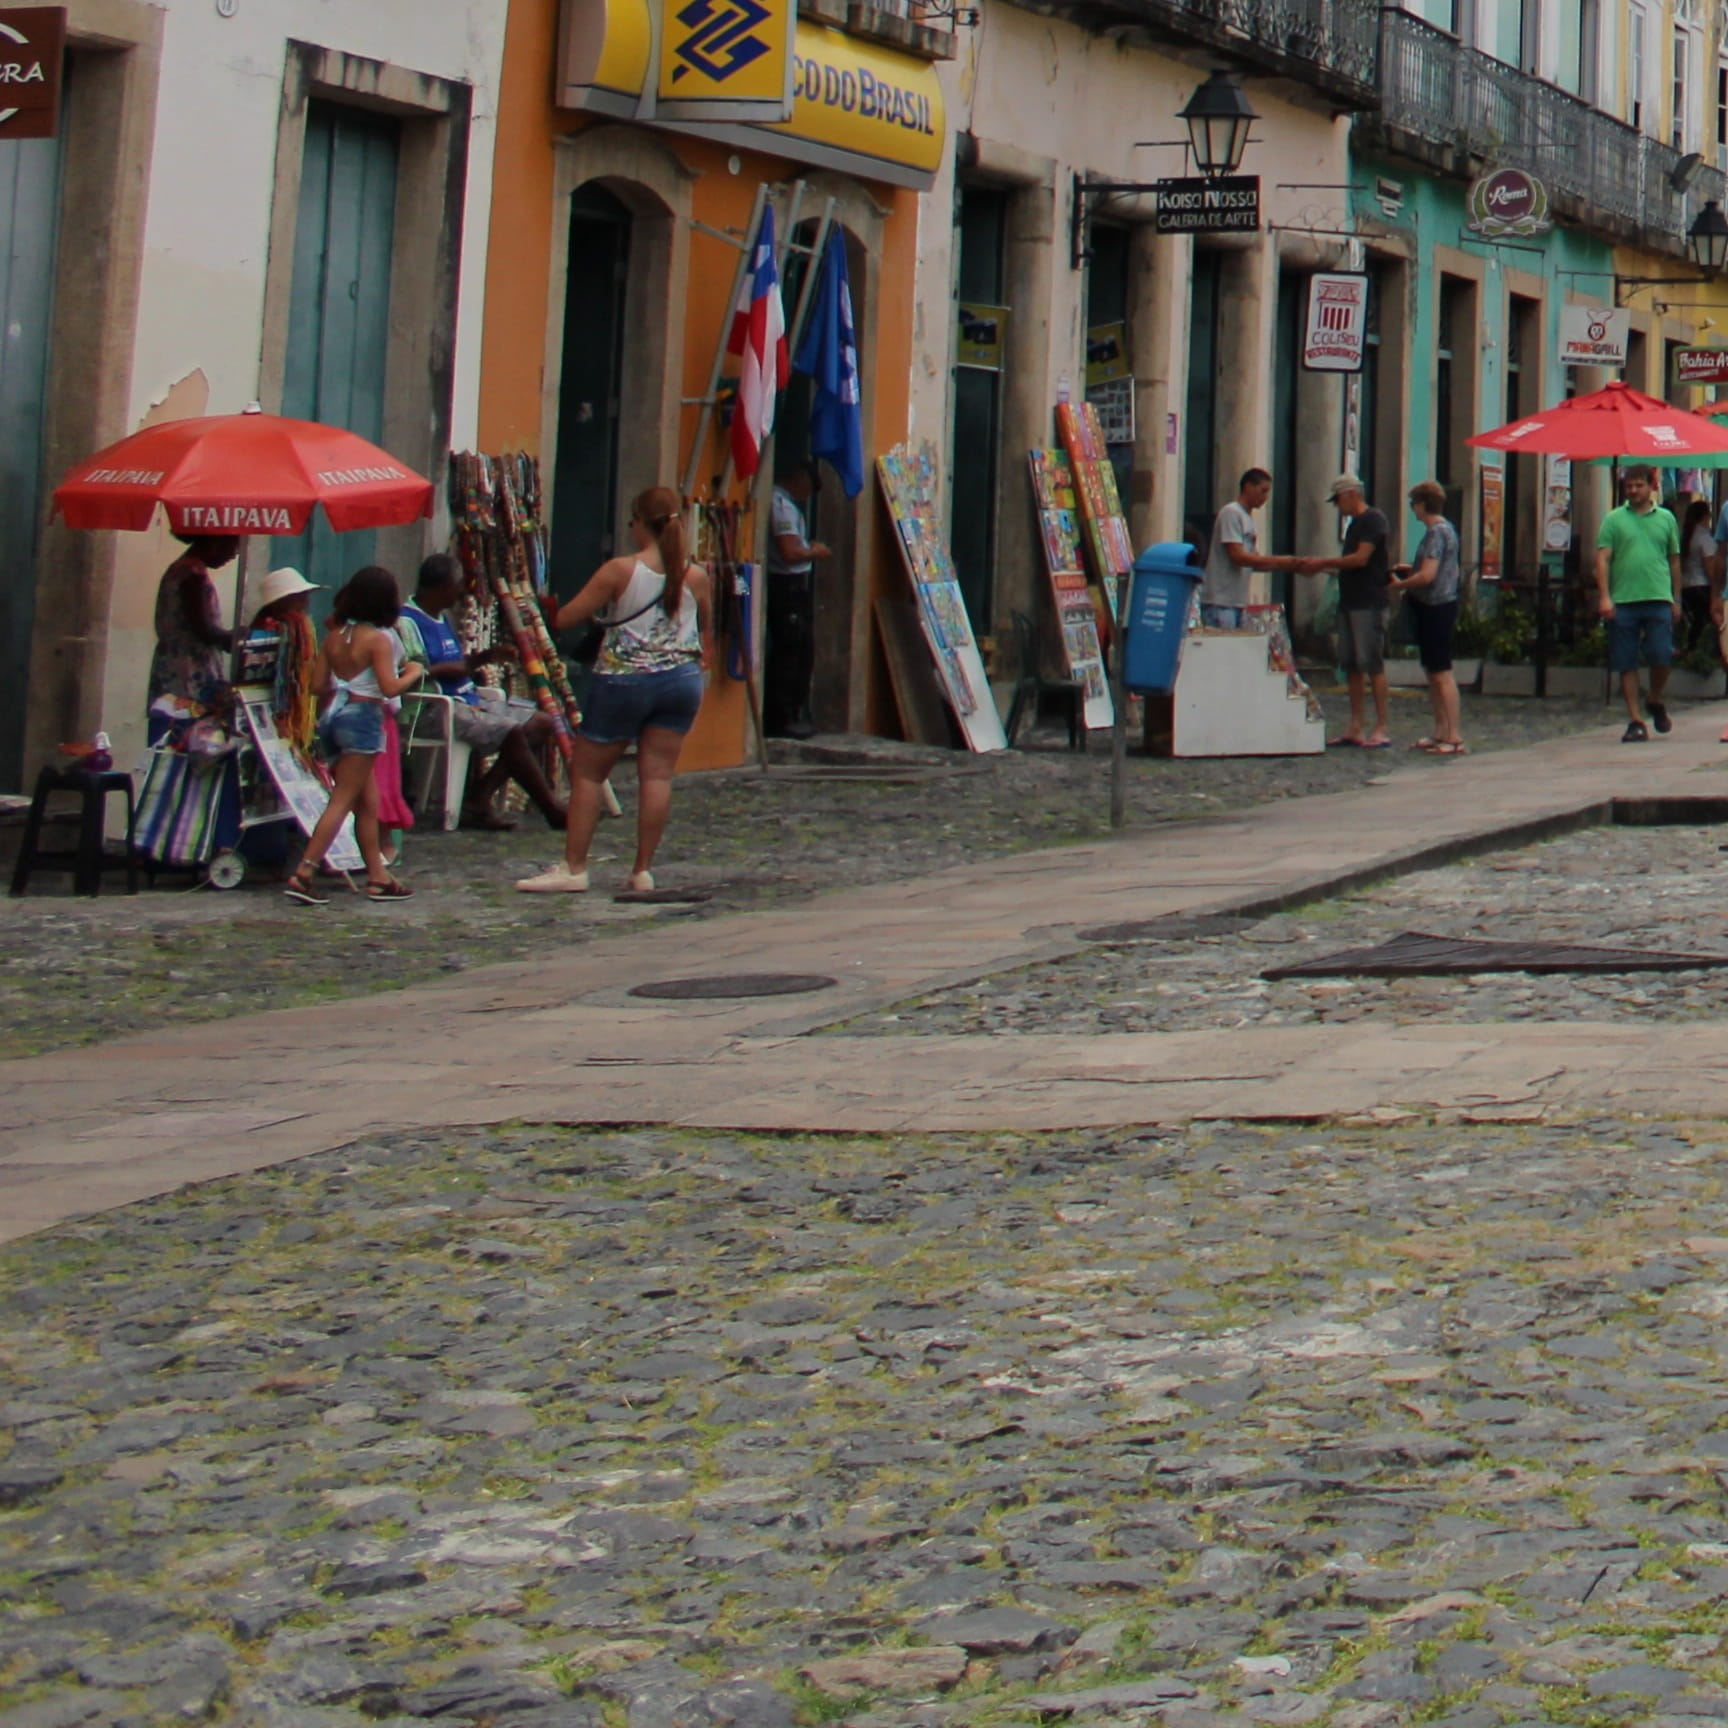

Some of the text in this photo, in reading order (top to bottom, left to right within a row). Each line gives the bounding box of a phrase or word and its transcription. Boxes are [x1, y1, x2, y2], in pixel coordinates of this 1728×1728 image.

[824, 64, 857, 112] DO
[858, 67, 934, 136] BRASIL
[1158, 211, 1257, 229] GALERIA DE ARTE
[1679, 352, 1715, 369] Bahia
[83, 469, 165, 485] ITAIPAVA
[317, 465, 406, 486] ITAIPAVA
[182, 506, 292, 529] ITAIPAVA
